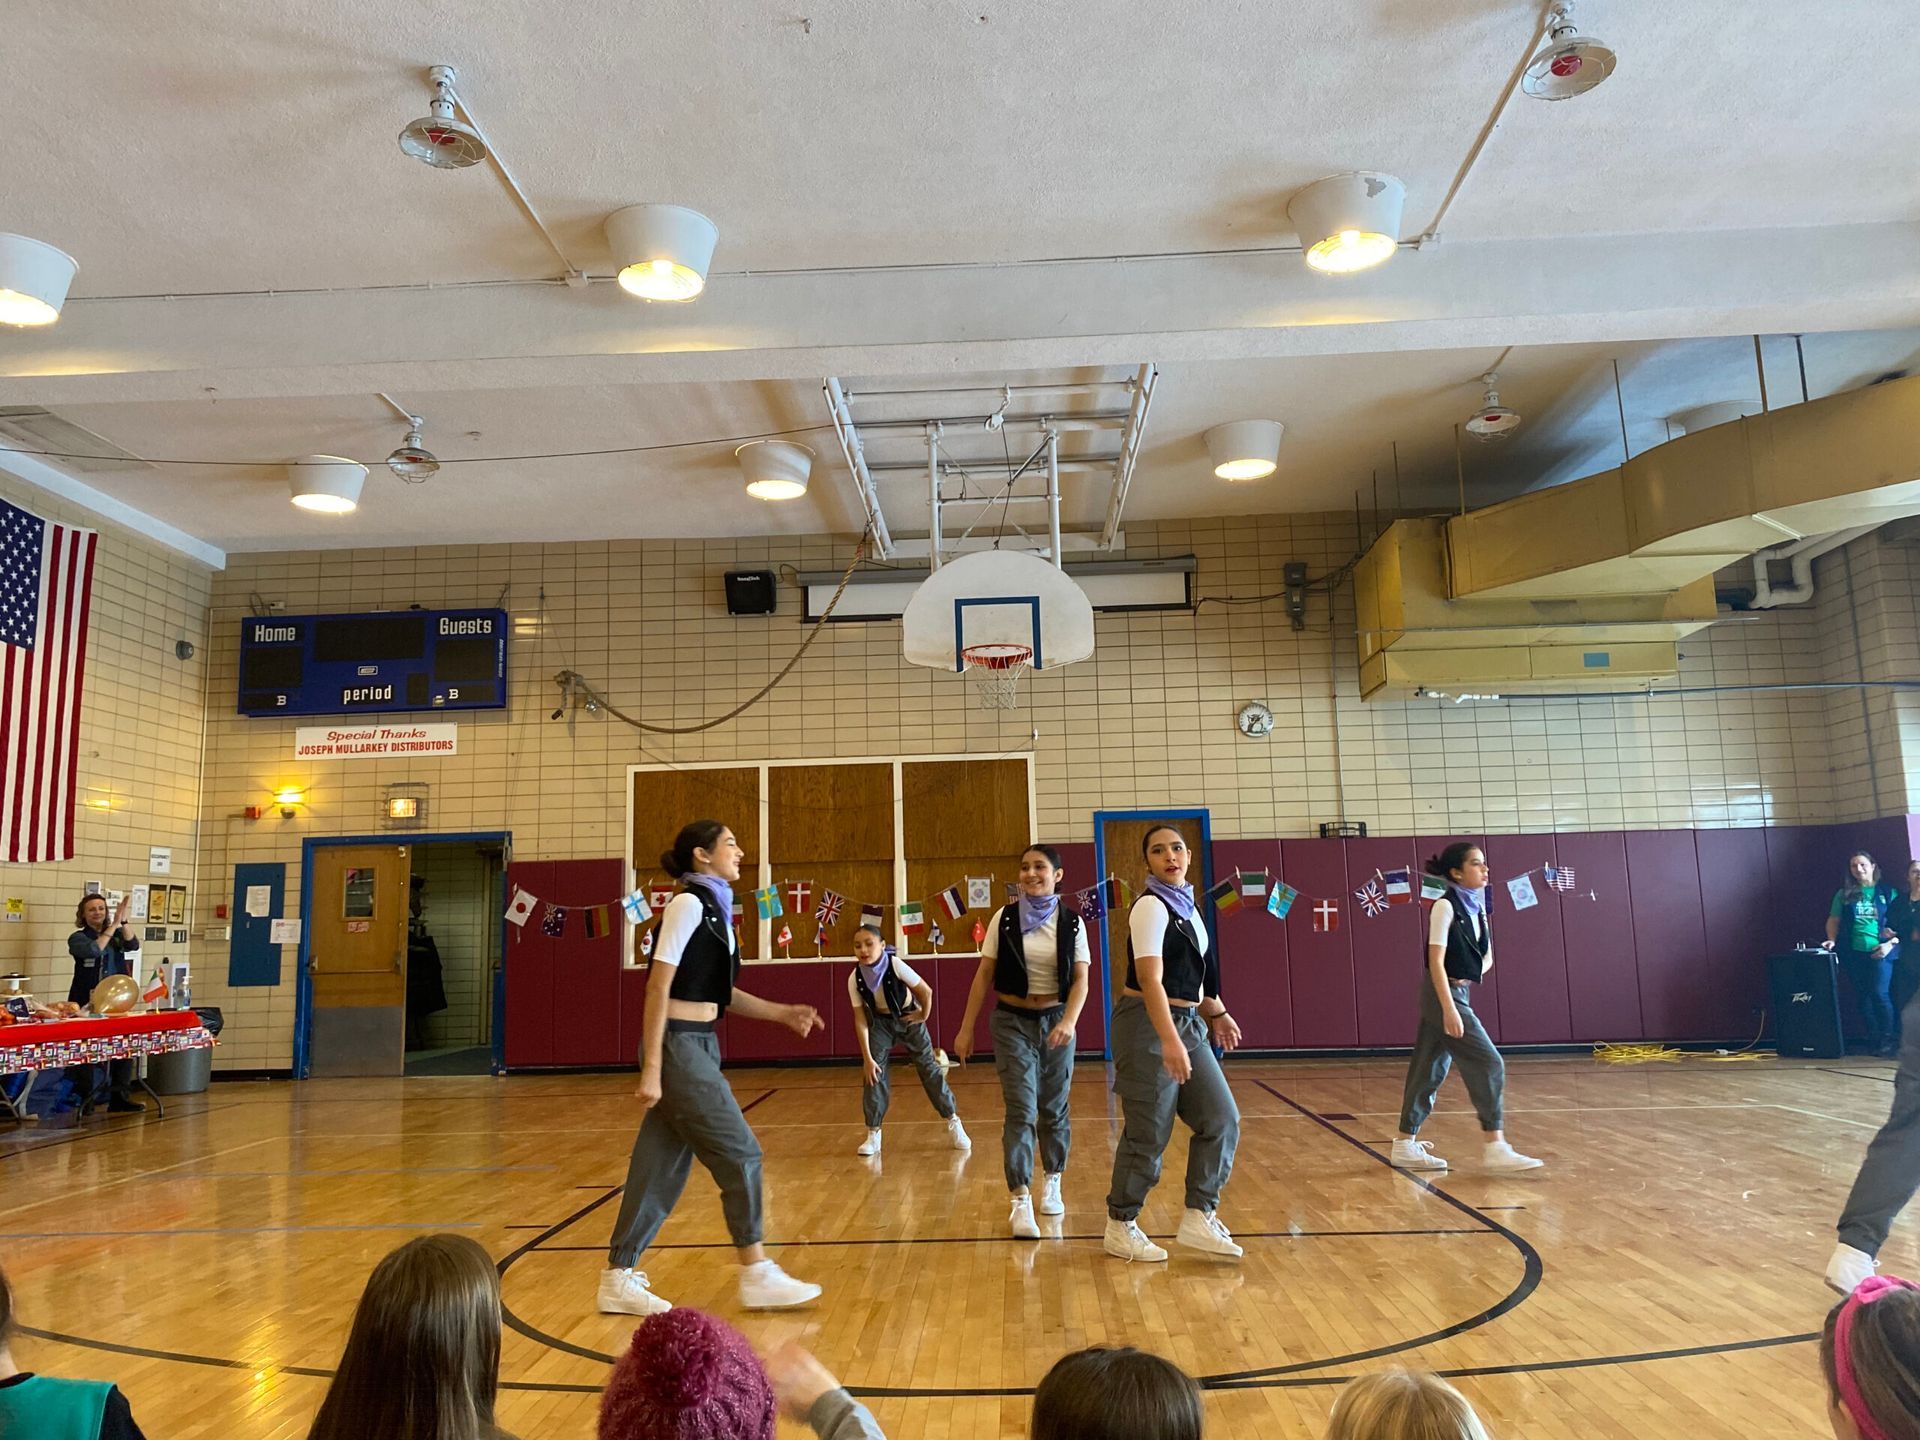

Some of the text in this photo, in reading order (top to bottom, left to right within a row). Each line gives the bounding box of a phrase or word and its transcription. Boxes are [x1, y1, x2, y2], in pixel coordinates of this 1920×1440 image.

[255, 624, 296, 642] Home
[440, 617, 492, 635] Guests
[276, 695, 287, 706] B
[343, 685, 392, 705] period
[448, 688, 459, 699] B
[327, 728, 427, 743] Special Thanks
[299, 740, 453, 755] JOSEPH MULLARKEY DISTRIBUTORS
